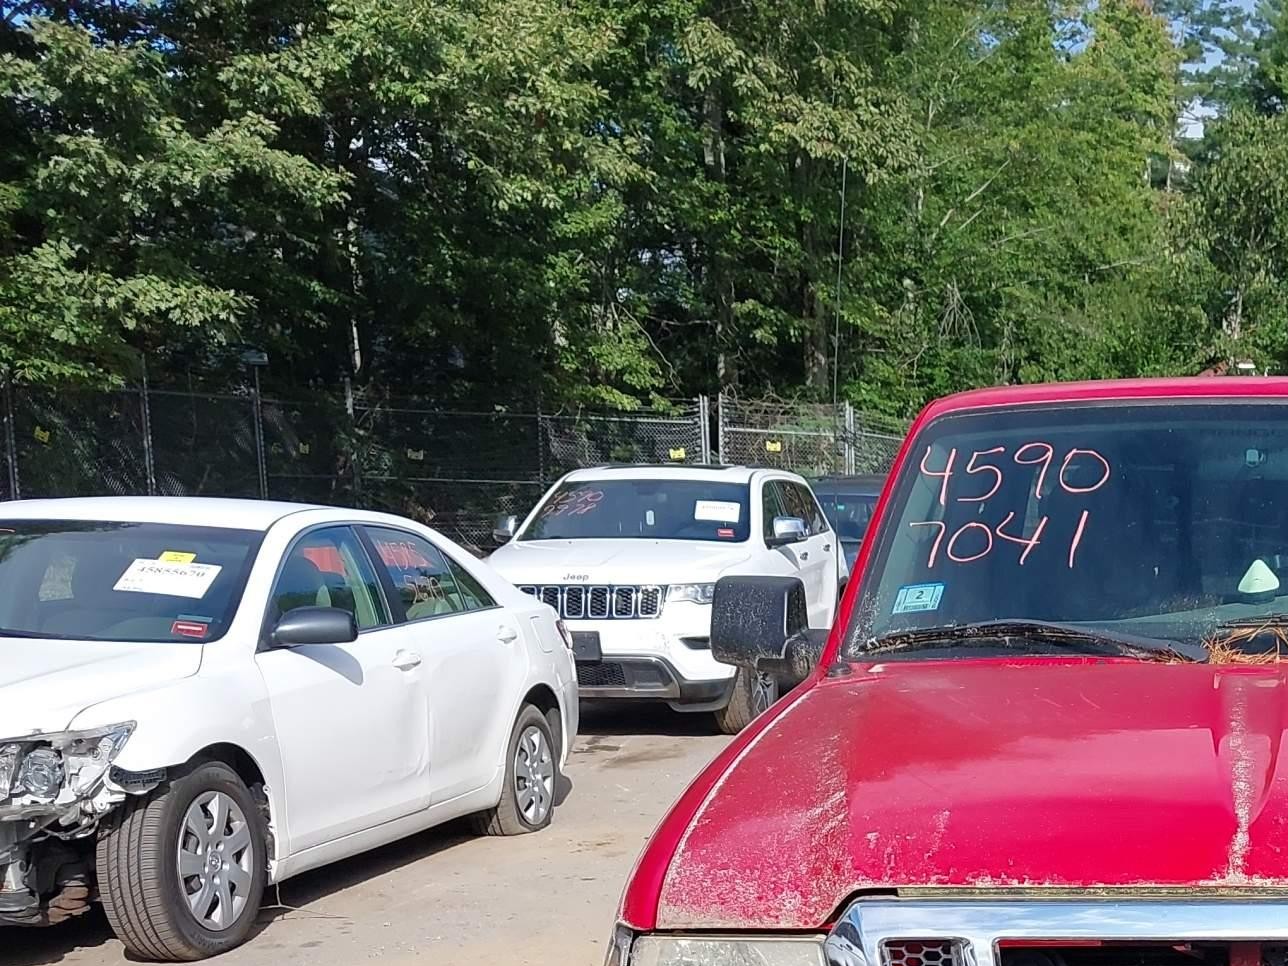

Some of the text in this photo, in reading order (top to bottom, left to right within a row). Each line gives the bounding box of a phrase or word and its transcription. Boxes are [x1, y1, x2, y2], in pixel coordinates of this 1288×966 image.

[919, 442, 1111, 505] 4590
[908, 510, 1090, 569] 7041
[562, 573, 590, 583] Jeep
[914, 590, 925, 600] 2
